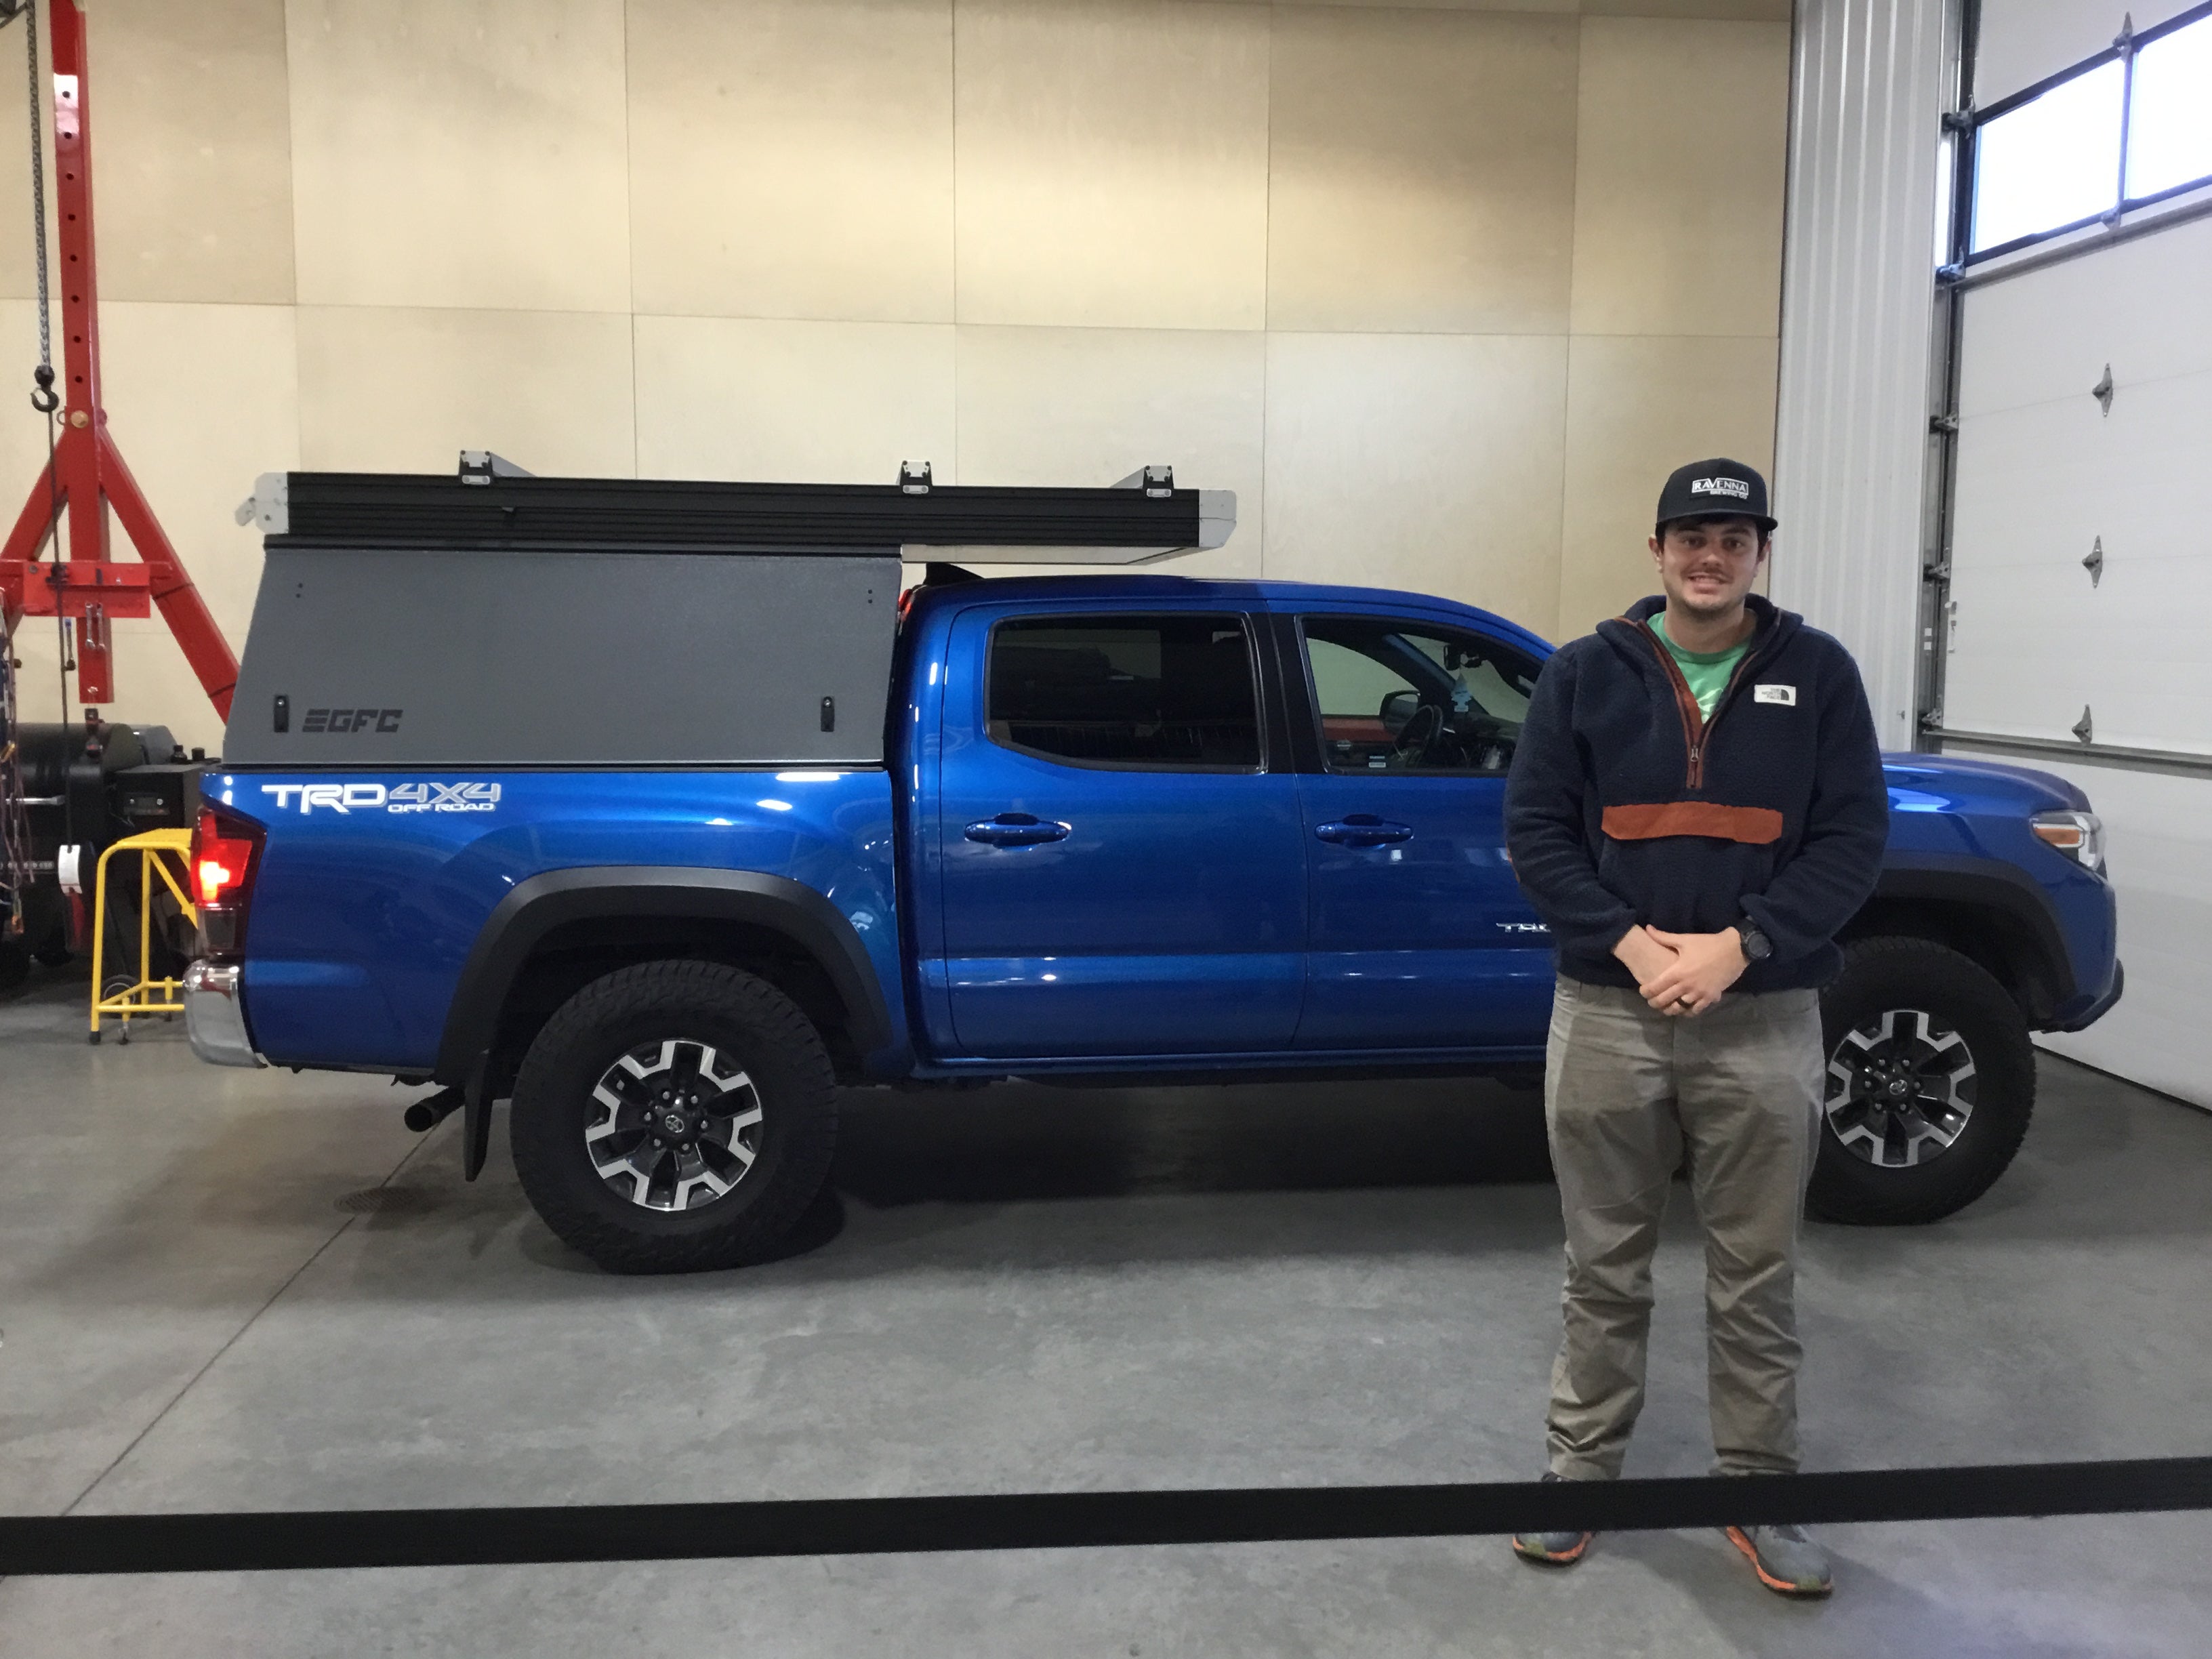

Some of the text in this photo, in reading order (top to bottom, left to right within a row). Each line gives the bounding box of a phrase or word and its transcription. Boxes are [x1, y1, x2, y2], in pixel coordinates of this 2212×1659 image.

[1694, 478, 1746, 492] RAVENNA
[262, 783, 386, 814] TRD
[388, 802, 496, 813] OFF ROAD
